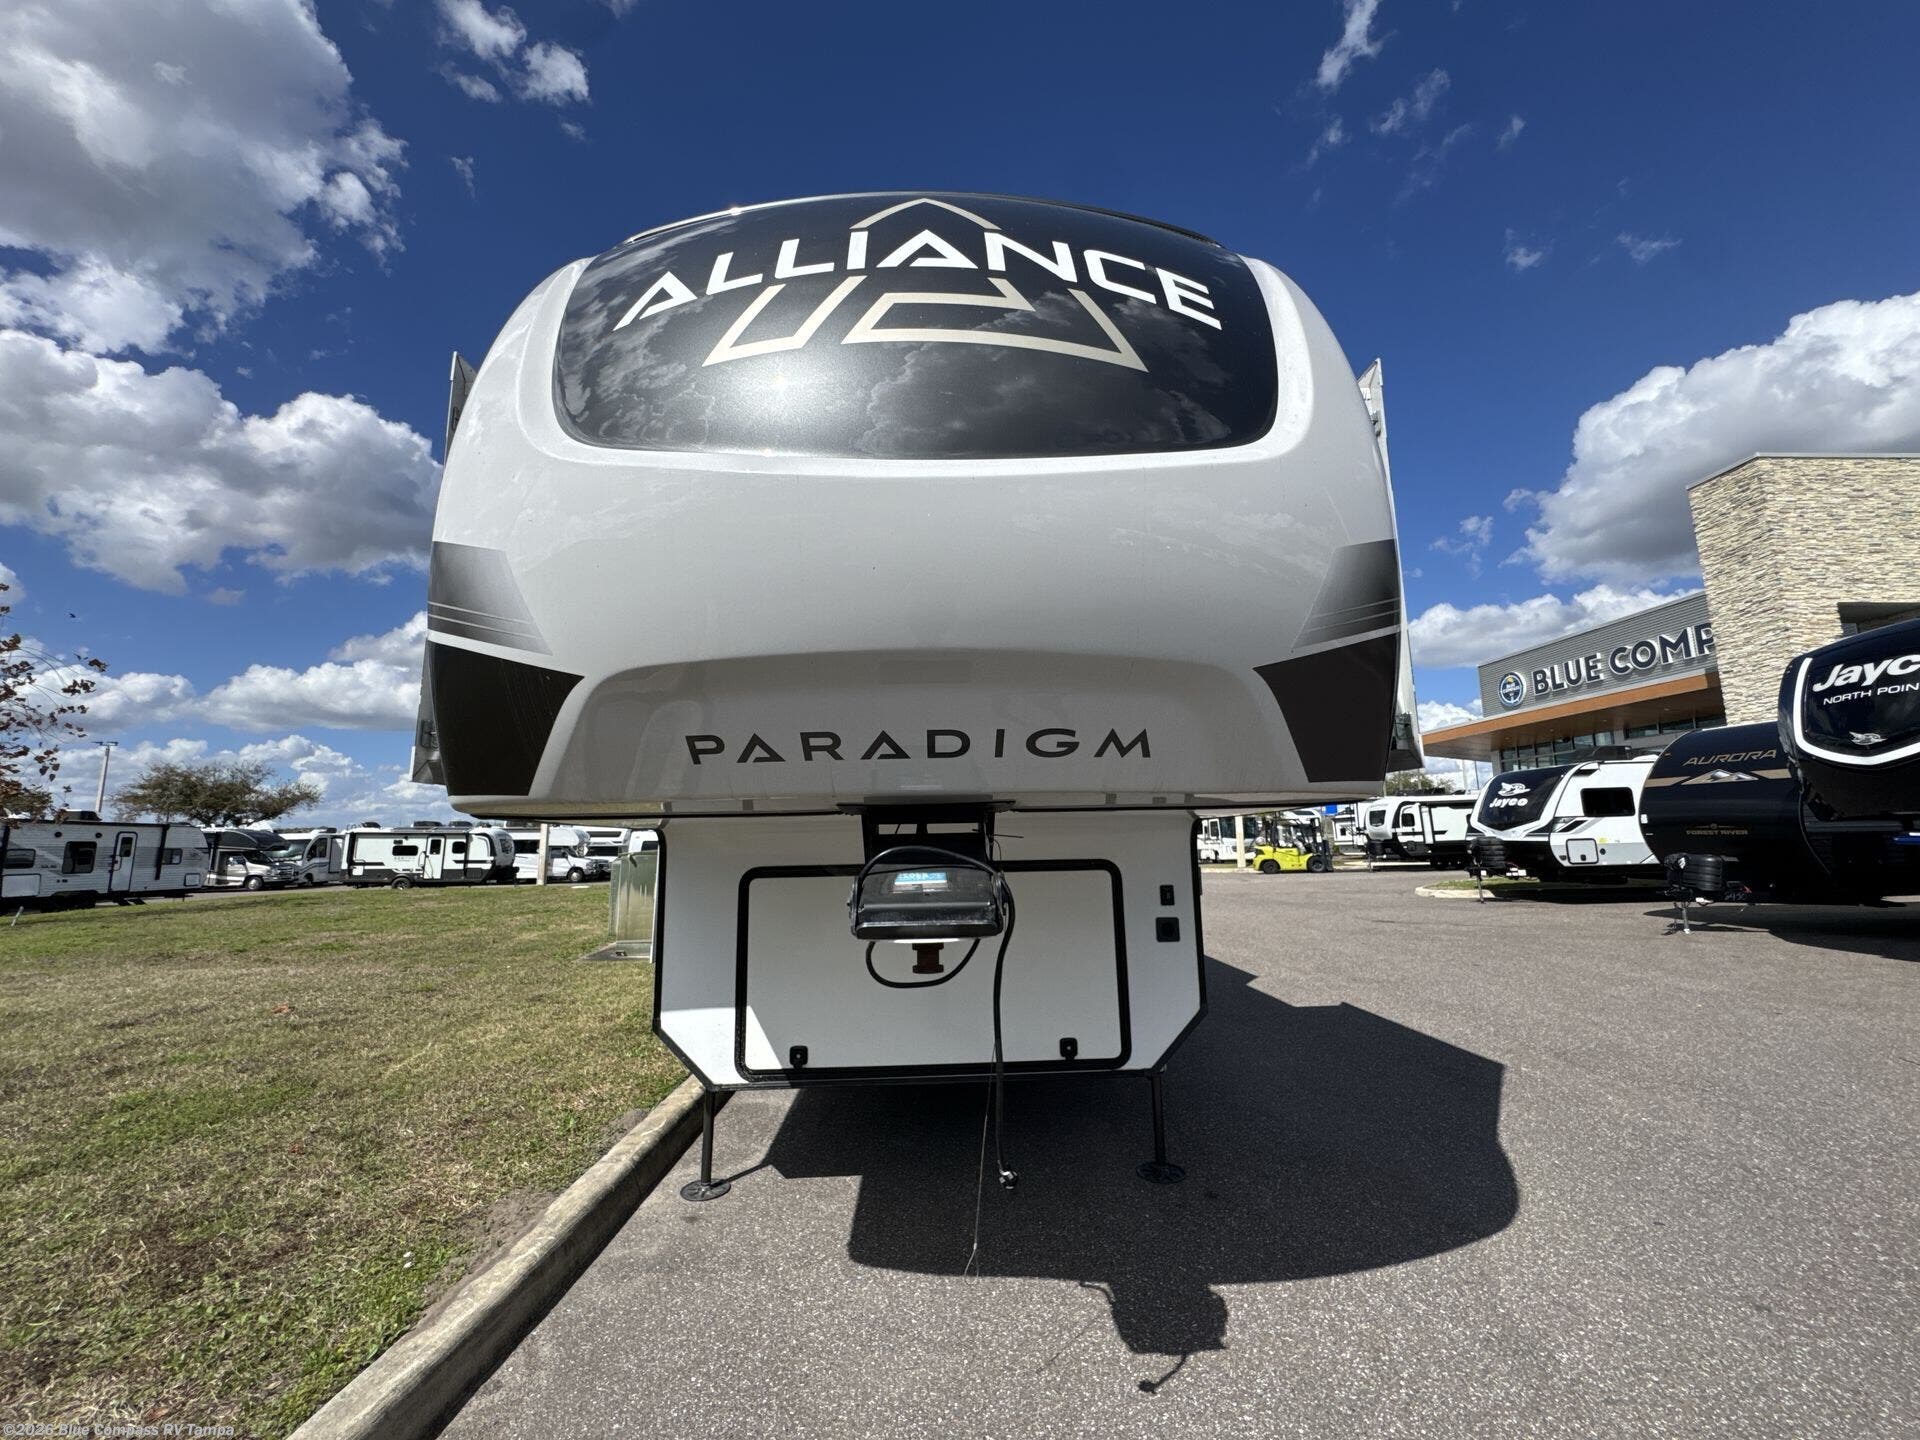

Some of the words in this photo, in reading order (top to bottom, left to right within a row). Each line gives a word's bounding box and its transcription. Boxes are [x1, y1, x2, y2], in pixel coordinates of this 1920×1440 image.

[613, 229, 1222, 330] ALLIANCE
[1532, 652, 1603, 696] BLUE
[1609, 622, 1715, 676] COMP
[1823, 690, 1872, 706] NORTH
[1877, 683, 1920, 696] POIN
[685, 728, 1151, 765] PARADIGM
[1682, 749, 1777, 767] AURORA
[1489, 797, 1529, 808] Jayco
